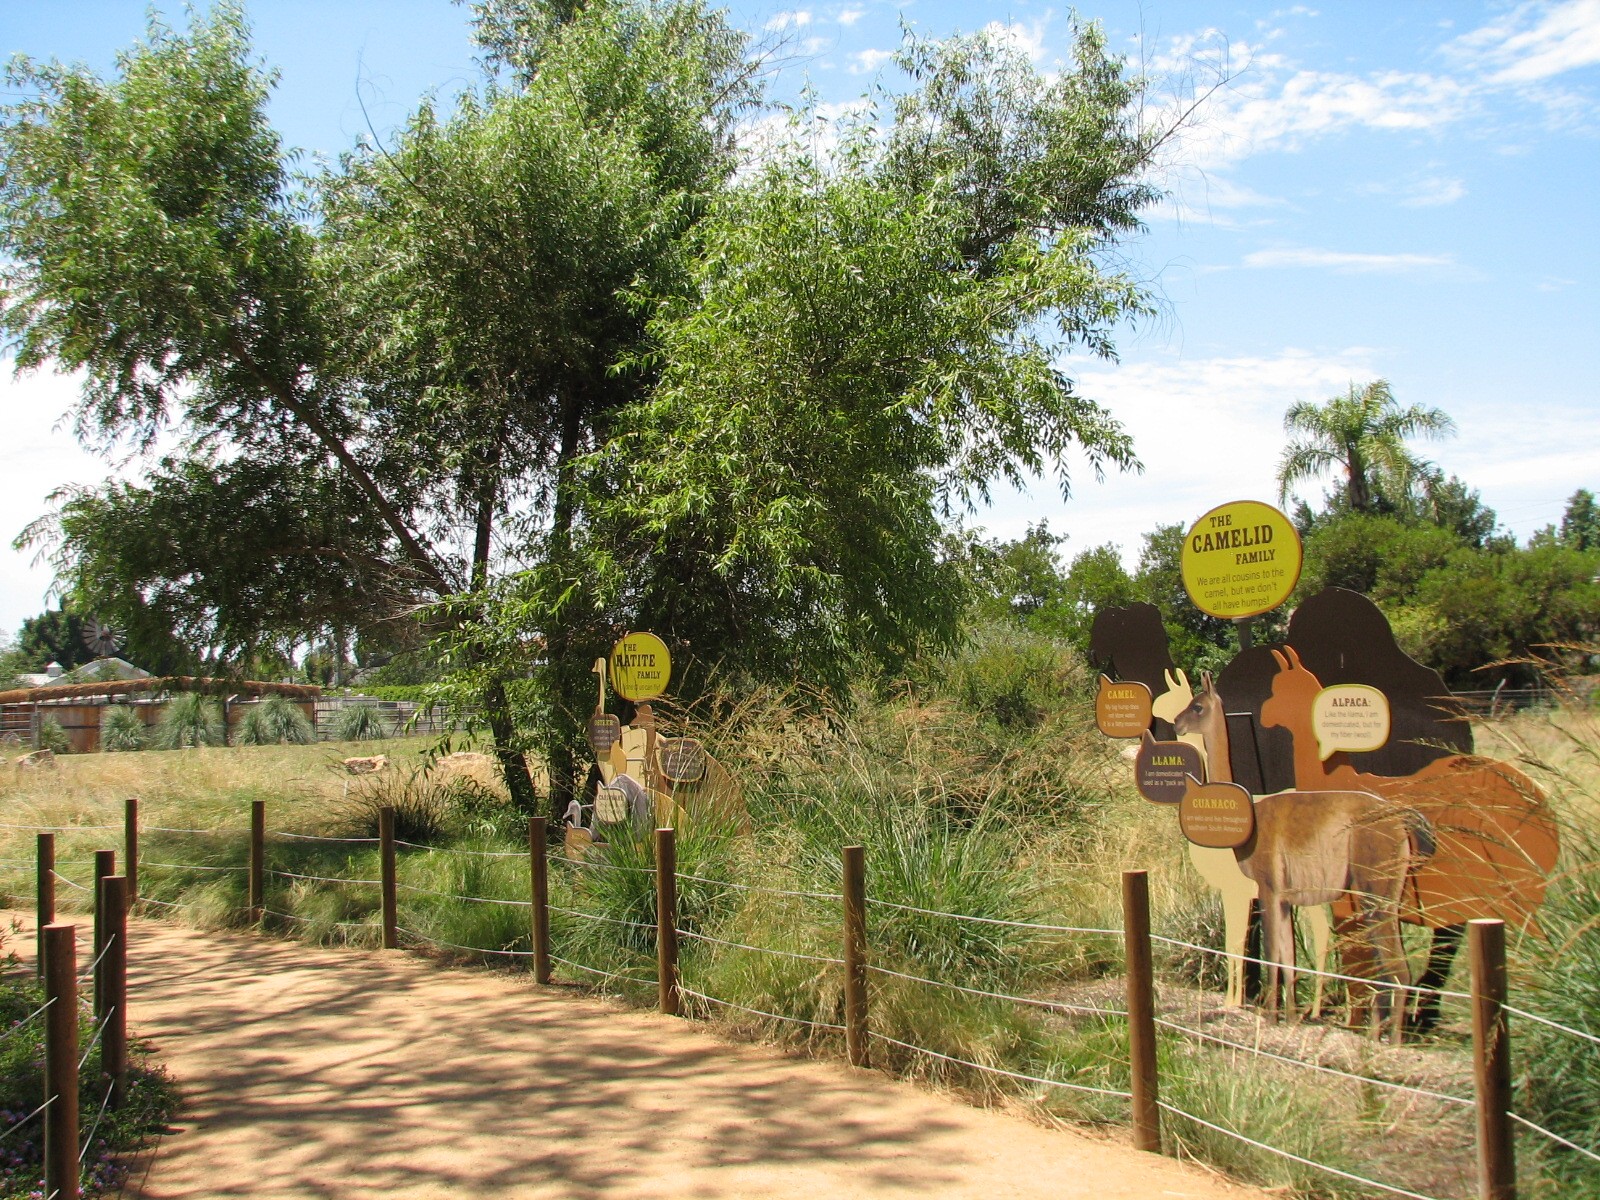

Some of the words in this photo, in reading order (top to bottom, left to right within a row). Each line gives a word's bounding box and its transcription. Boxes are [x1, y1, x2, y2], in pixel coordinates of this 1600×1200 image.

[1210, 514, 1232, 528] THE
[1192, 525, 1272, 553] CAMELID
[1236, 549, 1275, 565] FAMILY
[1196, 576, 1208, 587] We
[1208, 577, 1220, 586] are
[1221, 574, 1231, 583] all
[1231, 571, 1261, 582] cousins
[1263, 570, 1270, 579] to
[1271, 568, 1285, 577] the
[1204, 588, 1229, 600] camel,
[1231, 586, 1244, 596] but
[1244, 585, 1255, 594] we
[1257, 582, 1278, 592] don't
[1212, 601, 1222, 611] all
[1222, 599, 1240, 609] have
[1241, 596, 1270, 609] humps!
[616, 654, 656, 668] RATITE
[637, 671, 661, 679] FAMILY
[1107, 690, 1137, 700] CAMEL:
[1331, 698, 1371, 707] ALPACA:
[1151, 755, 1186, 766] LLAMA:
[1192, 798, 1239, 810] GUANACO:
